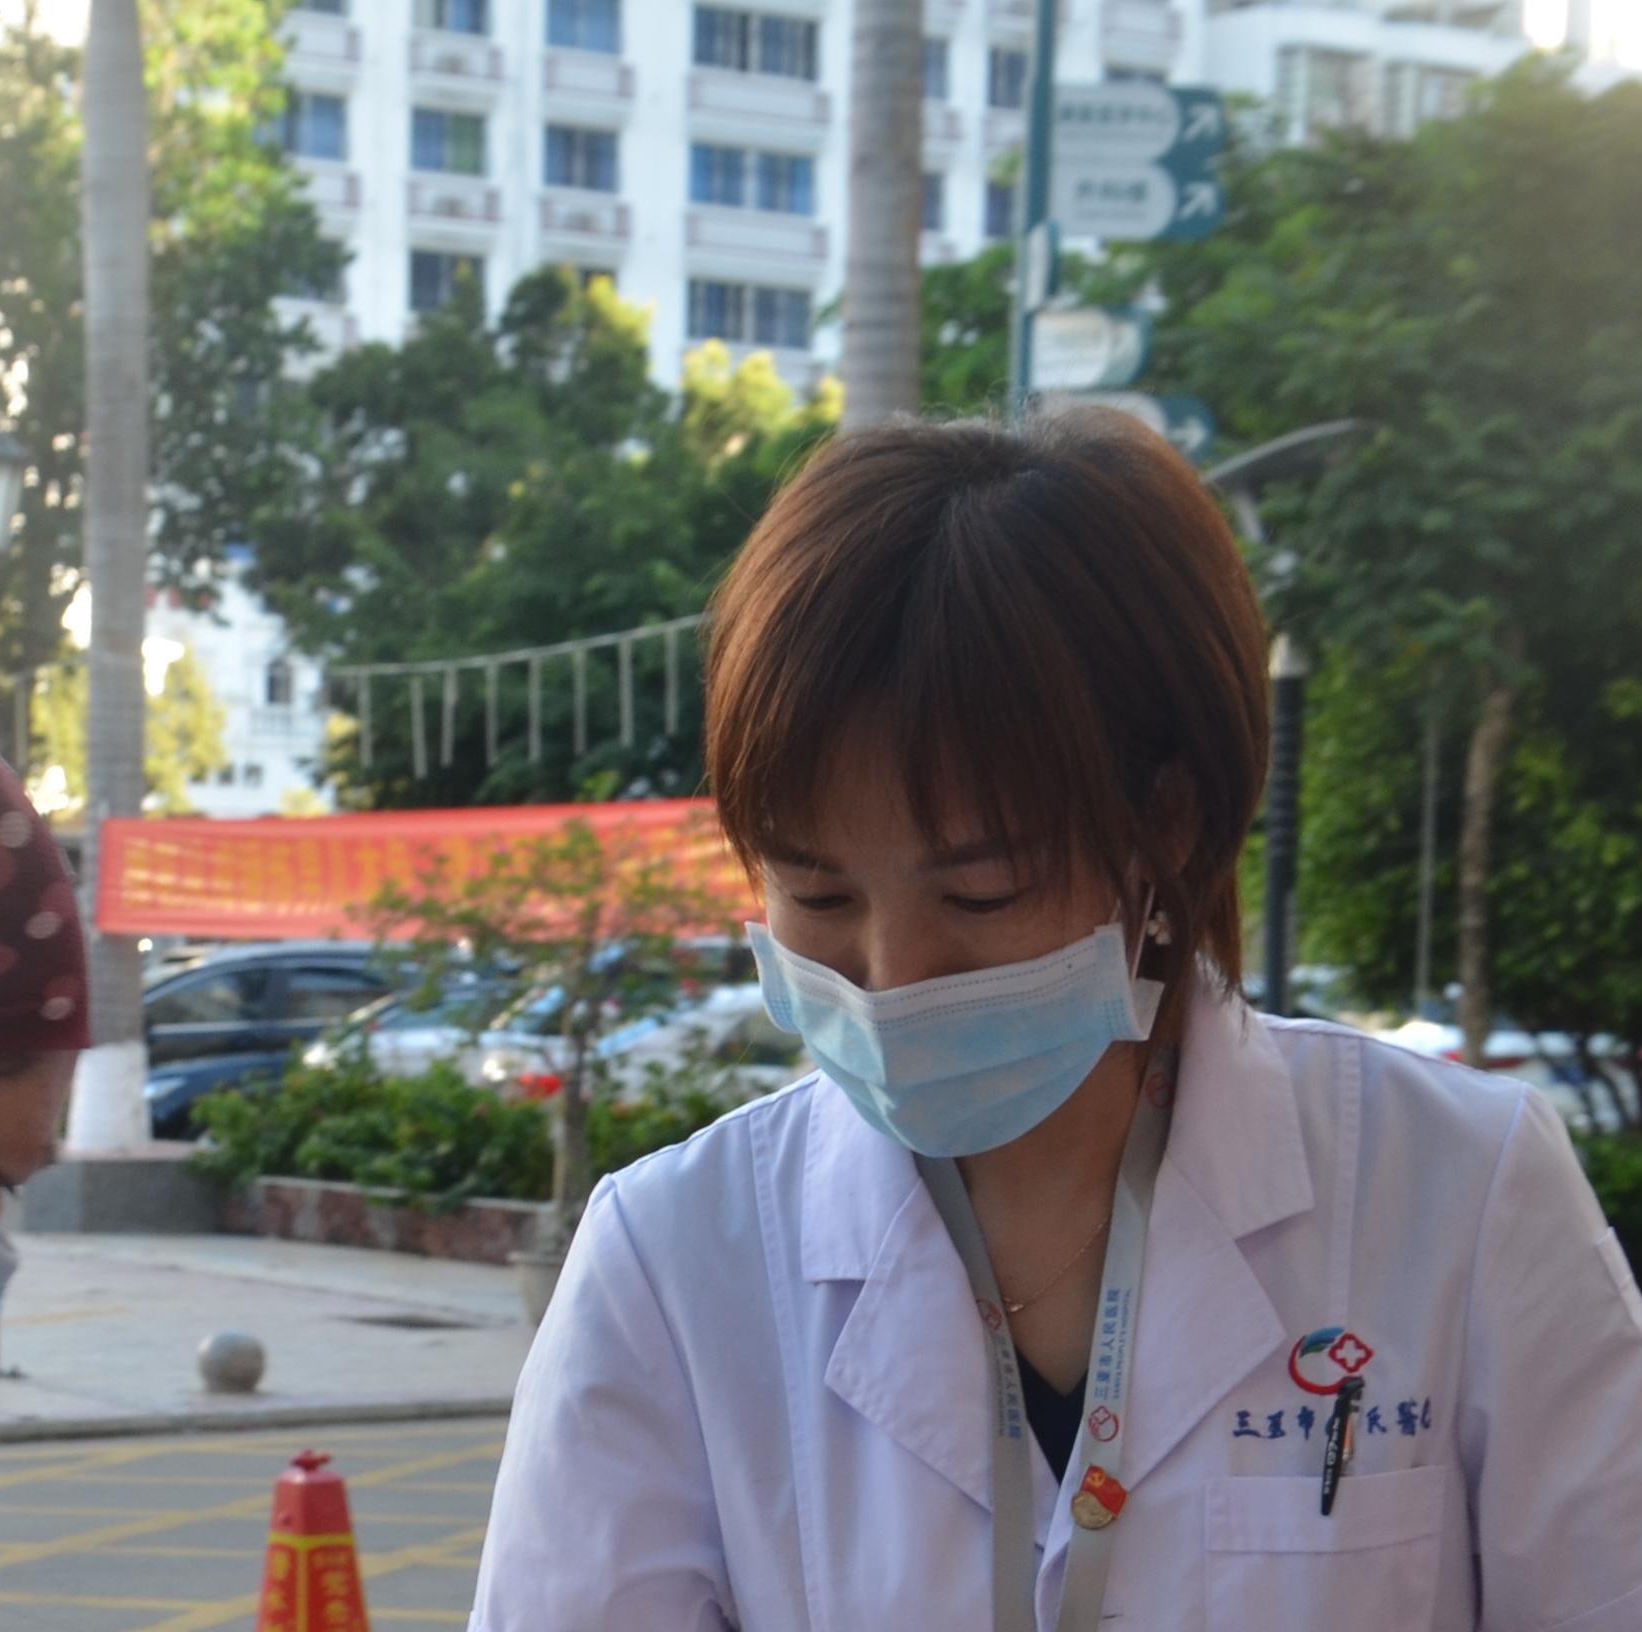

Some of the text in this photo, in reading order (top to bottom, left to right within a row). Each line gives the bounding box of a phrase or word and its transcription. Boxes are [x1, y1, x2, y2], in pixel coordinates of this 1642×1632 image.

[1094, 1289, 1120, 1400] 三亚市人民医院
